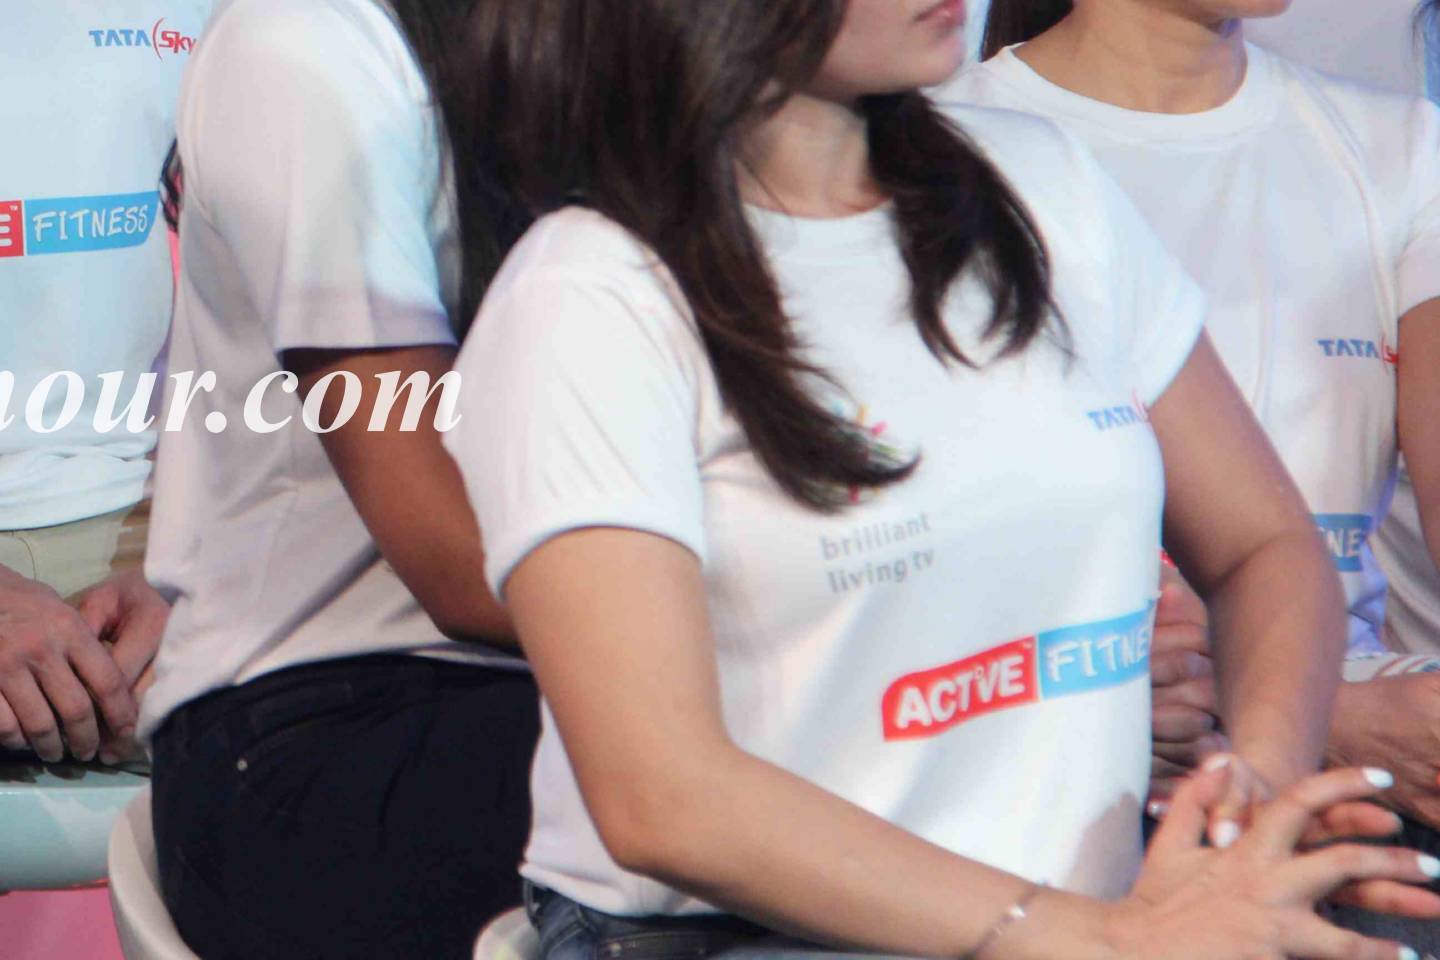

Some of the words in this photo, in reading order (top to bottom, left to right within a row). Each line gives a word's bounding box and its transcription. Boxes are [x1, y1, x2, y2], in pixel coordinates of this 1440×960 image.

[88, 28, 152, 47] TATA
[33, 203, 149, 243] FITNESS
[1317, 338, 1380, 359] TATA
[819, 511, 931, 561] brilliant
[825, 557, 909, 594] living
[911, 547, 937, 573] tv
[1045, 628, 1150, 683] FITNE
